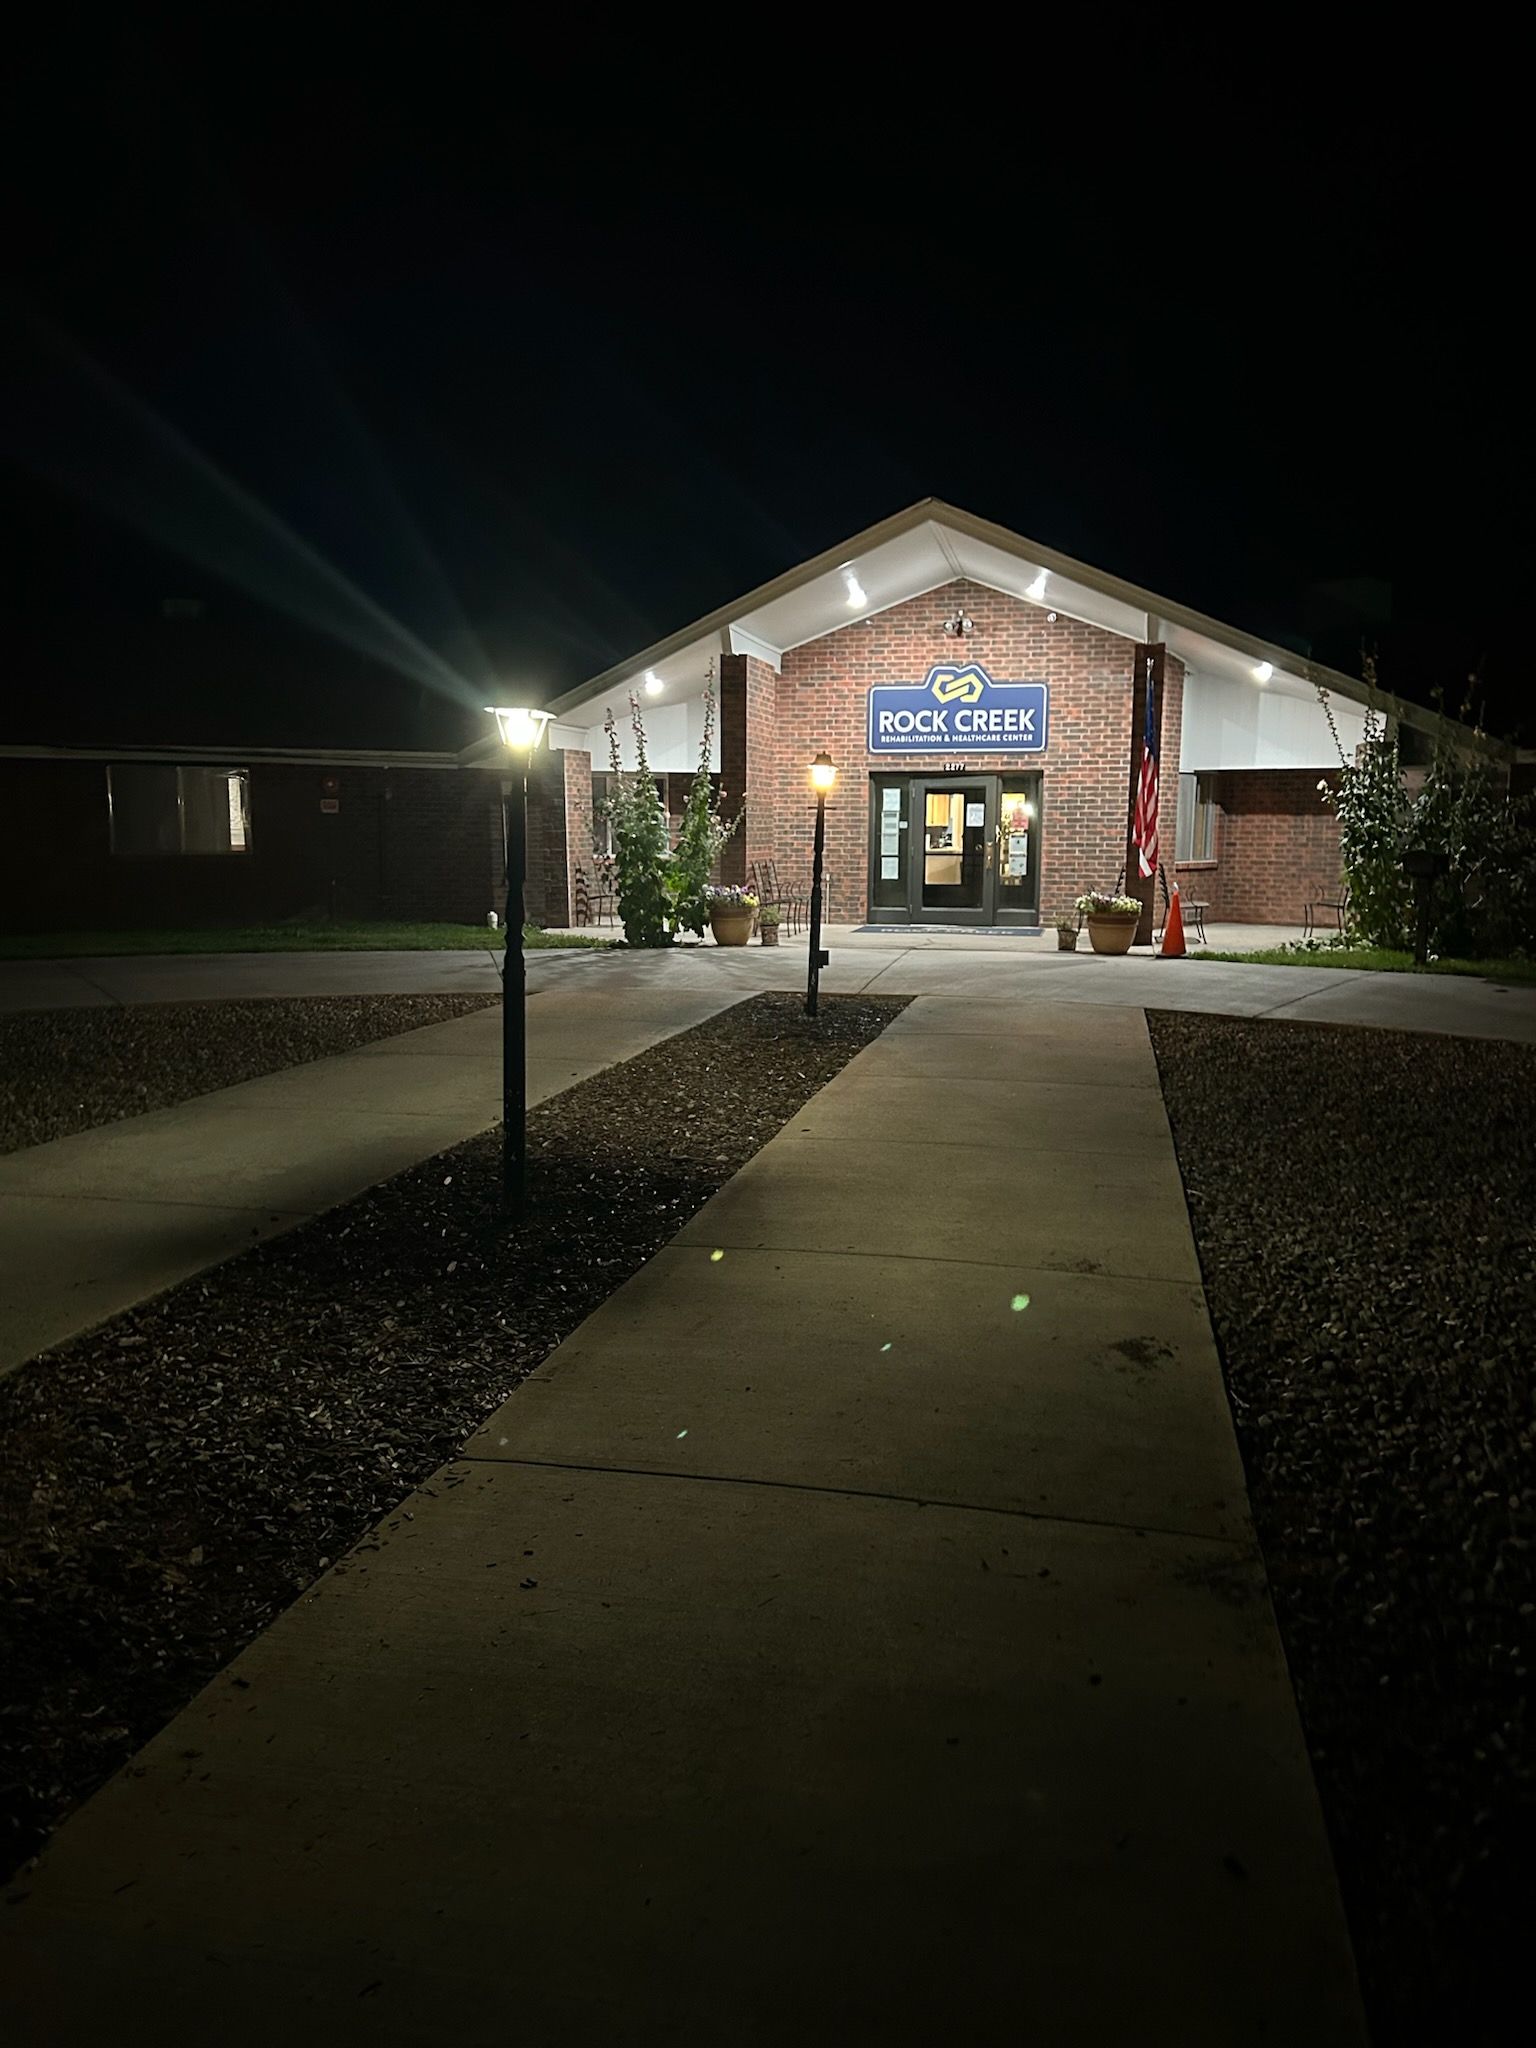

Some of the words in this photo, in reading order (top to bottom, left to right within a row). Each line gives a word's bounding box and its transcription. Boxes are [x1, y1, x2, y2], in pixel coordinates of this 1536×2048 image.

[879, 710, 949, 733] ROCK
[954, 709, 1035, 732] CREEK
[880, 734, 942, 743] REHABILITATION
[943, 734, 951, 742] &
[952, 734, 1001, 742] HEALTHCARE
[1002, 733, 1033, 742] CENTER
